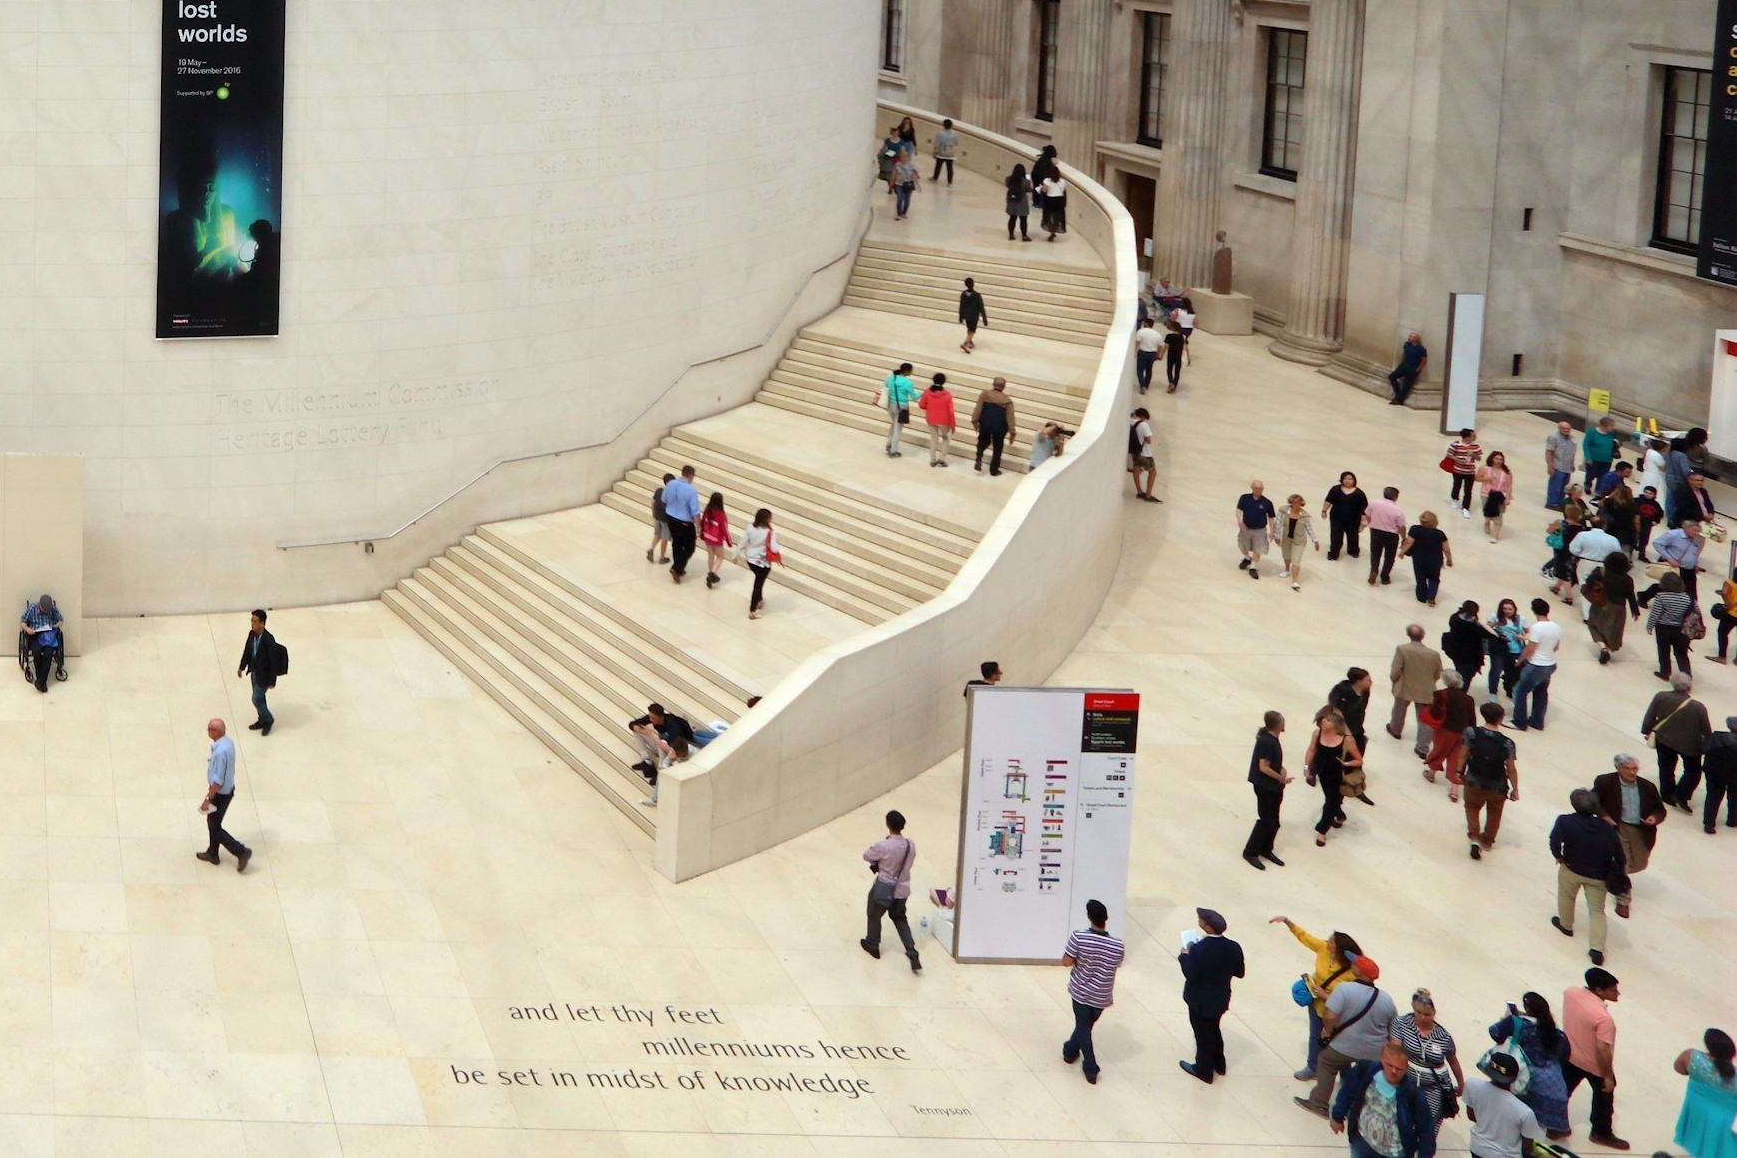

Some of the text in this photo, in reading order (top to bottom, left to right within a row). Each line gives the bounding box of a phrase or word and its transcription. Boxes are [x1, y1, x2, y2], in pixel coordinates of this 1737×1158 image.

[178, 0, 217, 19] lost
[177, 24, 248, 43] worlds
[216, 379, 501, 416] The Millennium Commission
[217, 427, 309, 453] Heritage
[317, 422, 389, 445] Lottery
[509, 1003, 725, 1027] and let thy feet
[642, 1037, 911, 1061] millenniums hence
[451, 1065, 875, 1099] be set in midst of knowledge
[909, 1104, 972, 1117] Tennyson
